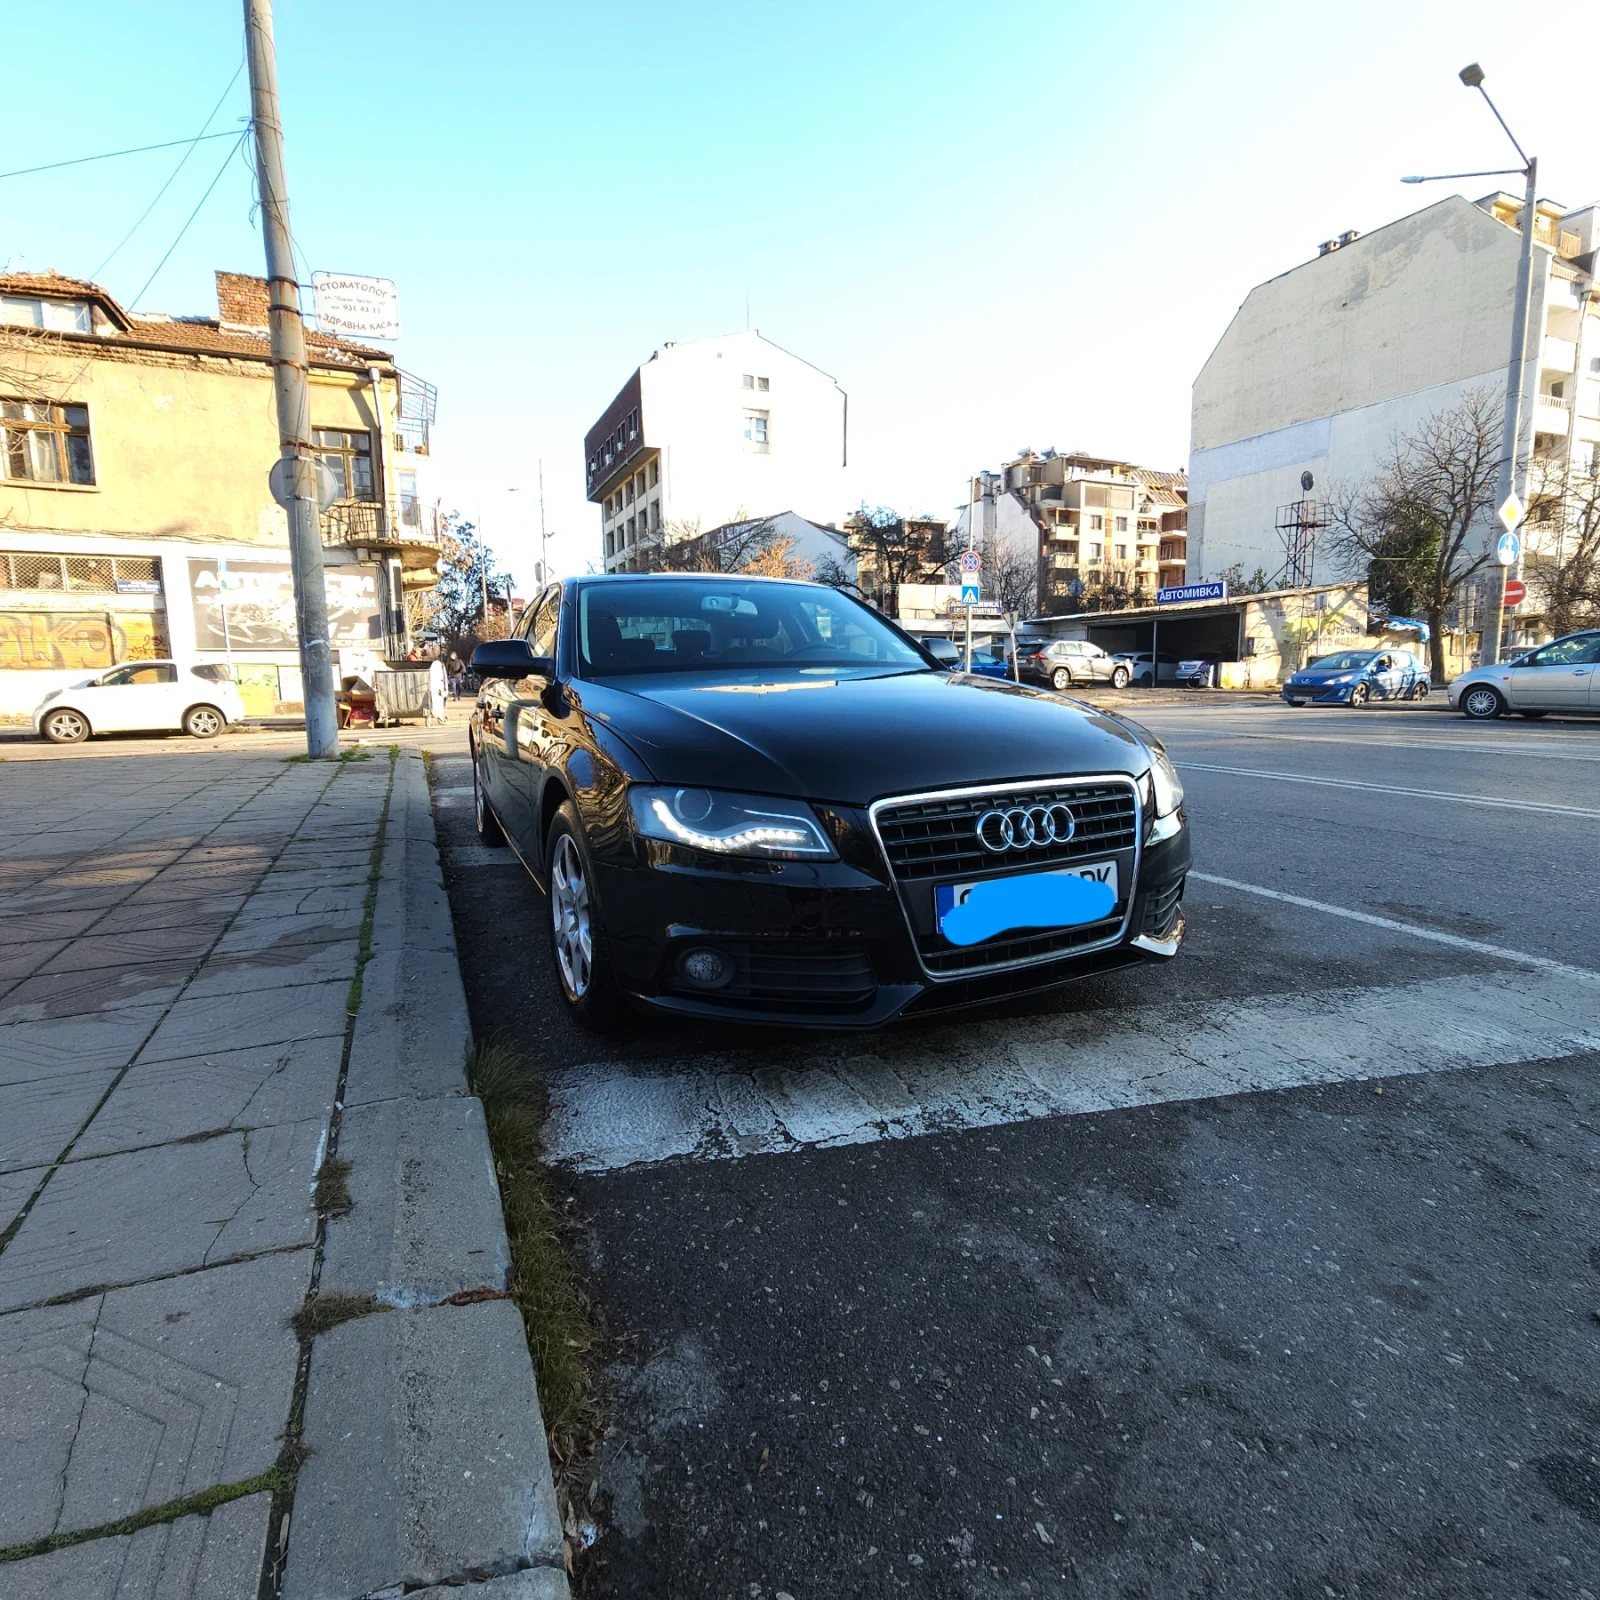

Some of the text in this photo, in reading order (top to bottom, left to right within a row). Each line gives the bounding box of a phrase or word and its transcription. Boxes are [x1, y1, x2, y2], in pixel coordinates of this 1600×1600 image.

[320, 281, 388, 298] СТОМАТОЛОГ
[323, 313, 392, 330] ЗДРАВНА КАСА
[1159, 585, 1220, 601] АВТОМИВКА
